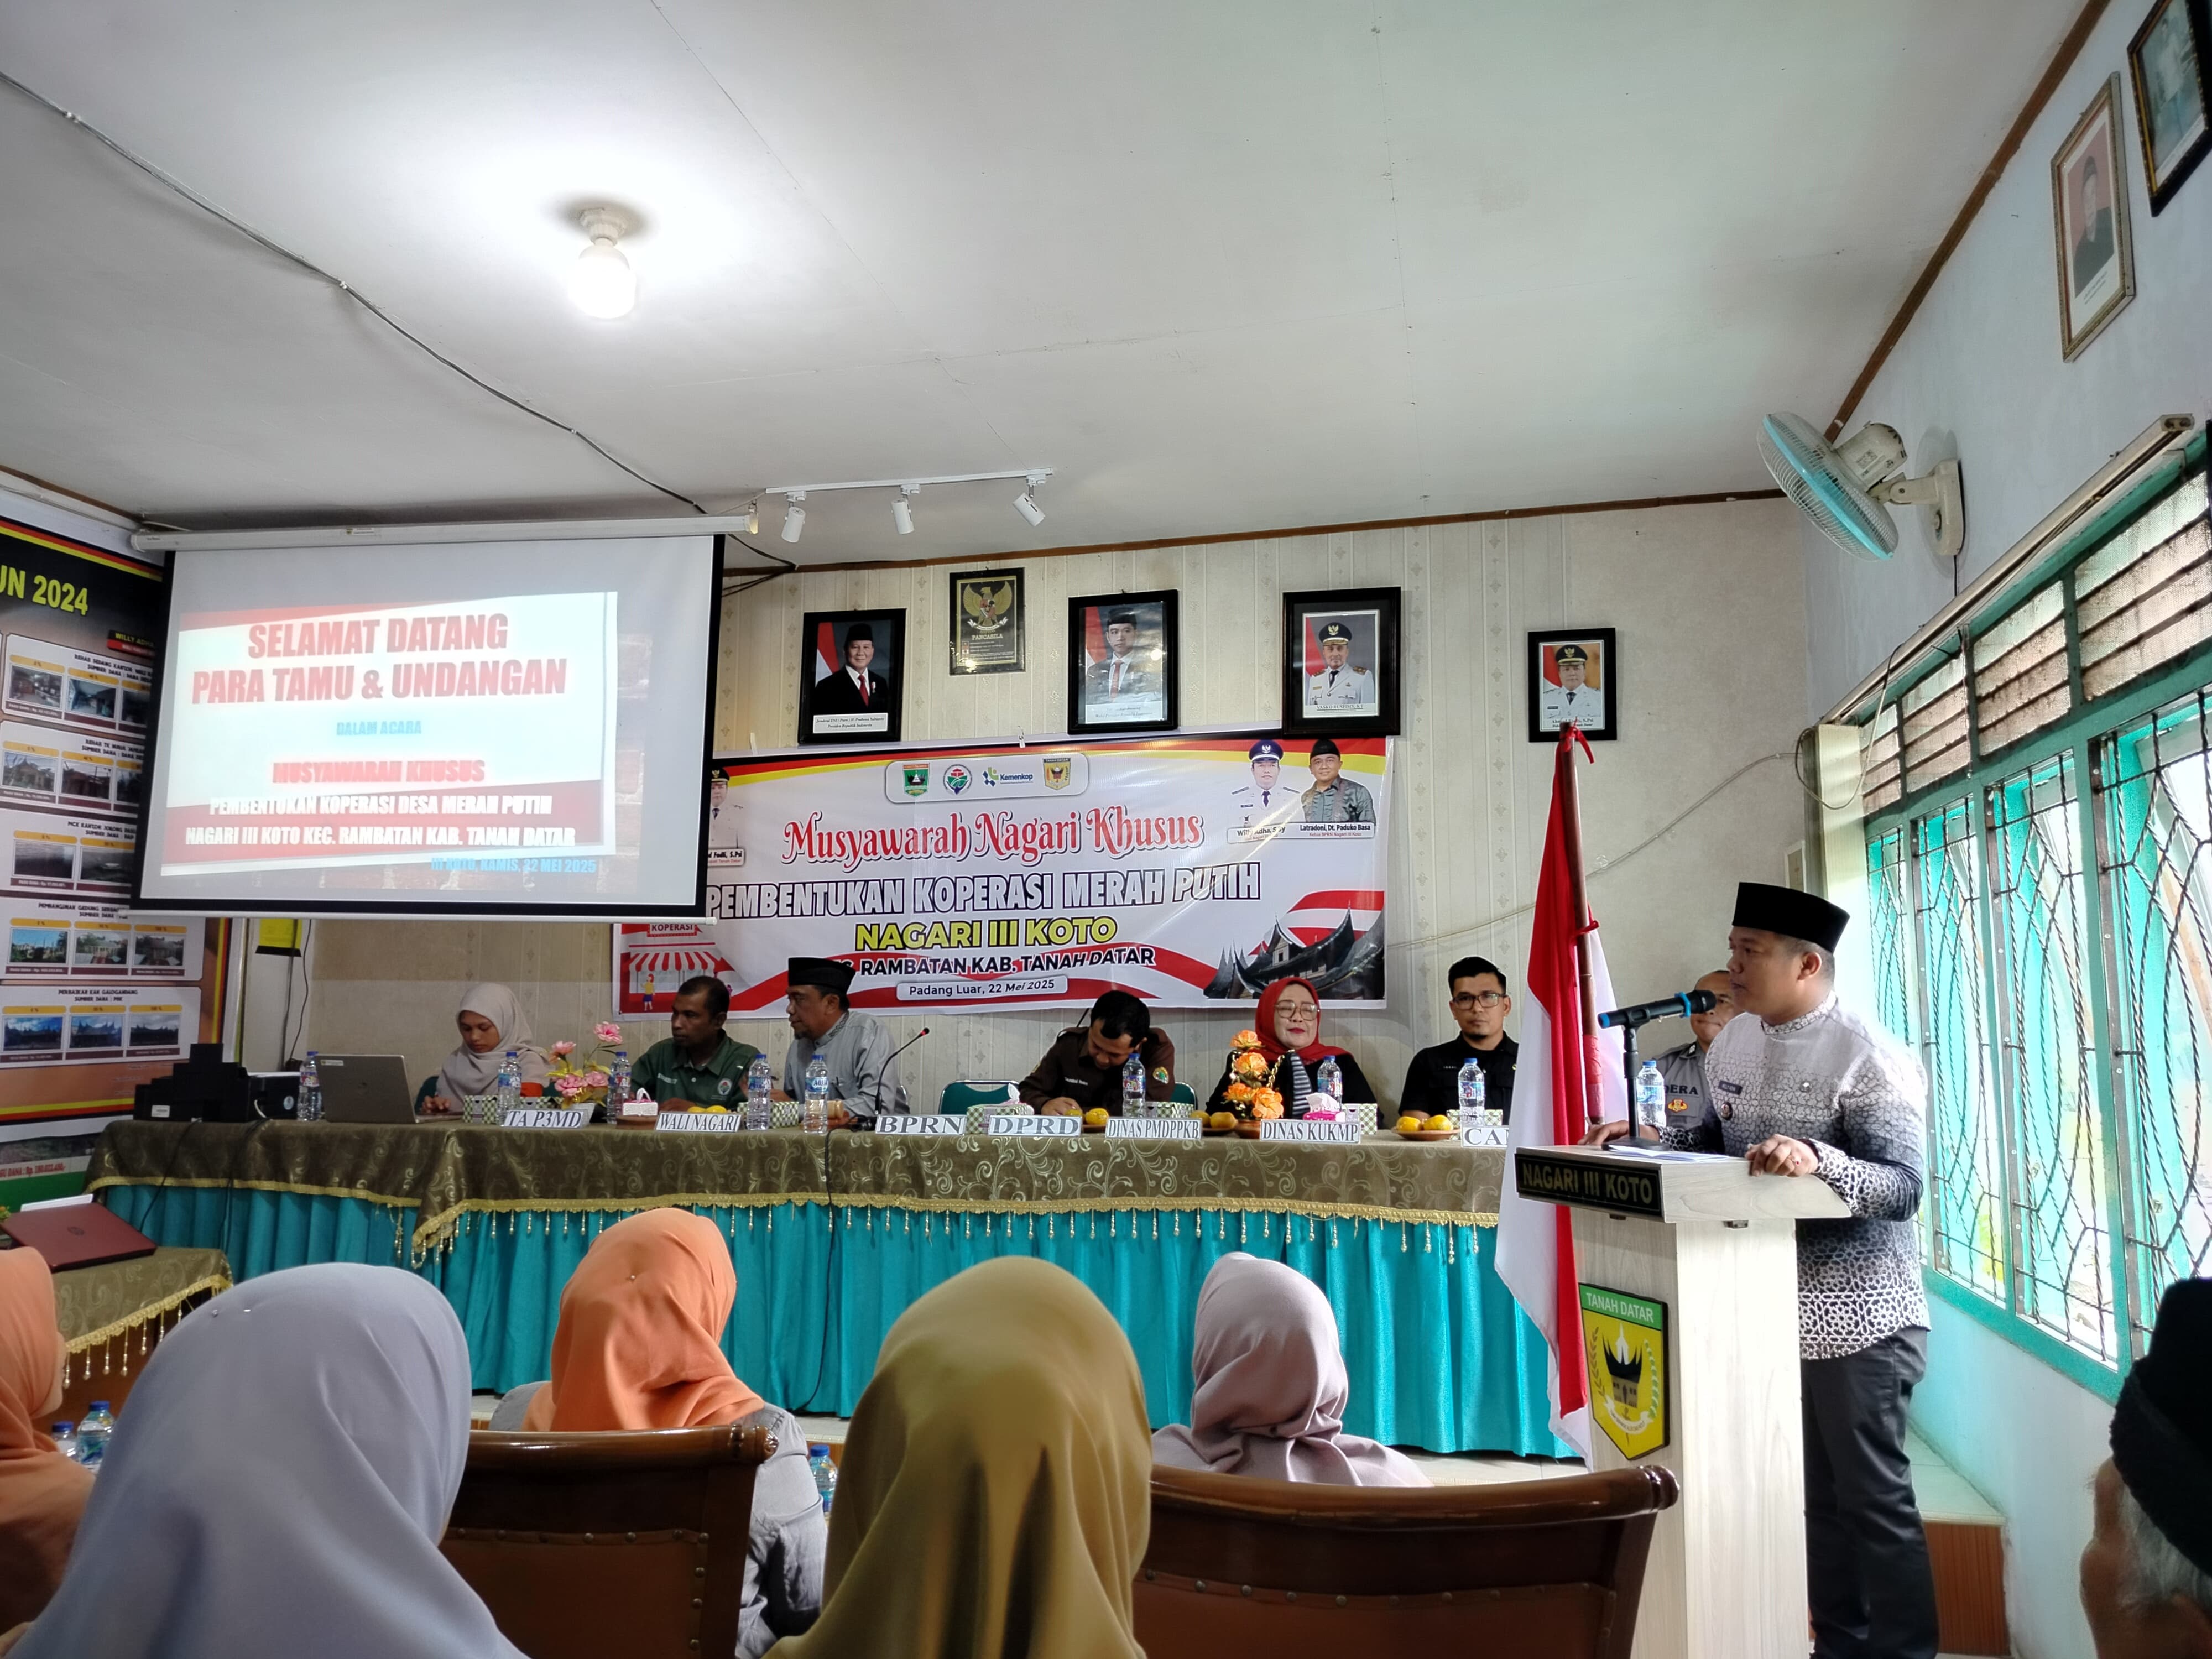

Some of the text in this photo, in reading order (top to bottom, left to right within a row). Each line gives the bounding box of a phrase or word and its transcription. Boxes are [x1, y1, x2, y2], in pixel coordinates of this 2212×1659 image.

[32, 575, 88, 615] 2024
[248, 613, 508, 659] SELAMAT DATANG
[192, 658, 567, 705] PARA TAMU & UNDANGAN
[336, 720, 422, 736] DALAM ACARA
[272, 760, 486, 784] MUSYAWARAH KHUSUS
[1000, 773, 1033, 781] Kemenkop
[209, 795, 553, 815] PEMBENTUKAN KOPERASI DESA MERAH PUTIH
[185, 826, 576, 847] NAGARI III KOTO KEC. RAMBATAN KAB. TANAH DATAR
[781, 805, 1203, 870] Musyawarah Nagari Khusus
[481, 858, 520, 873] KAMIS,
[523, 859, 538, 873] 22
[540, 858, 562, 873] MEI
[564, 859, 597, 873] 2025
[706, 862, 1261, 920] PEMBENTUKAN KOPERASI MERAH PUTIH
[651, 924, 693, 932] KOPERASI
[855, 915, 1118, 952] NAGARI III KOTO
[860, 947, 1156, 976] RAMBATAN KAB. TANAH DATAR
[909, 980, 1055, 997] Padang Luar, 22 Mei 2025
[508, 1110, 582, 1127] TA P3MD
[660, 1114, 739, 1131] WALI NAGARI
[879, 1116, 963, 1134] BPRN
[993, 1118, 1079, 1135] DPRD
[1108, 1119, 1199, 1139] DINAS PMDPPKB
[1263, 1121, 1358, 1141] DINAS KUKMP
[1464, 1128, 1509, 1145] CA
[1522, 1162, 1653, 1204] NAGARI III KOTO
[1586, 1292, 1654, 1323] TANAH DATAR
